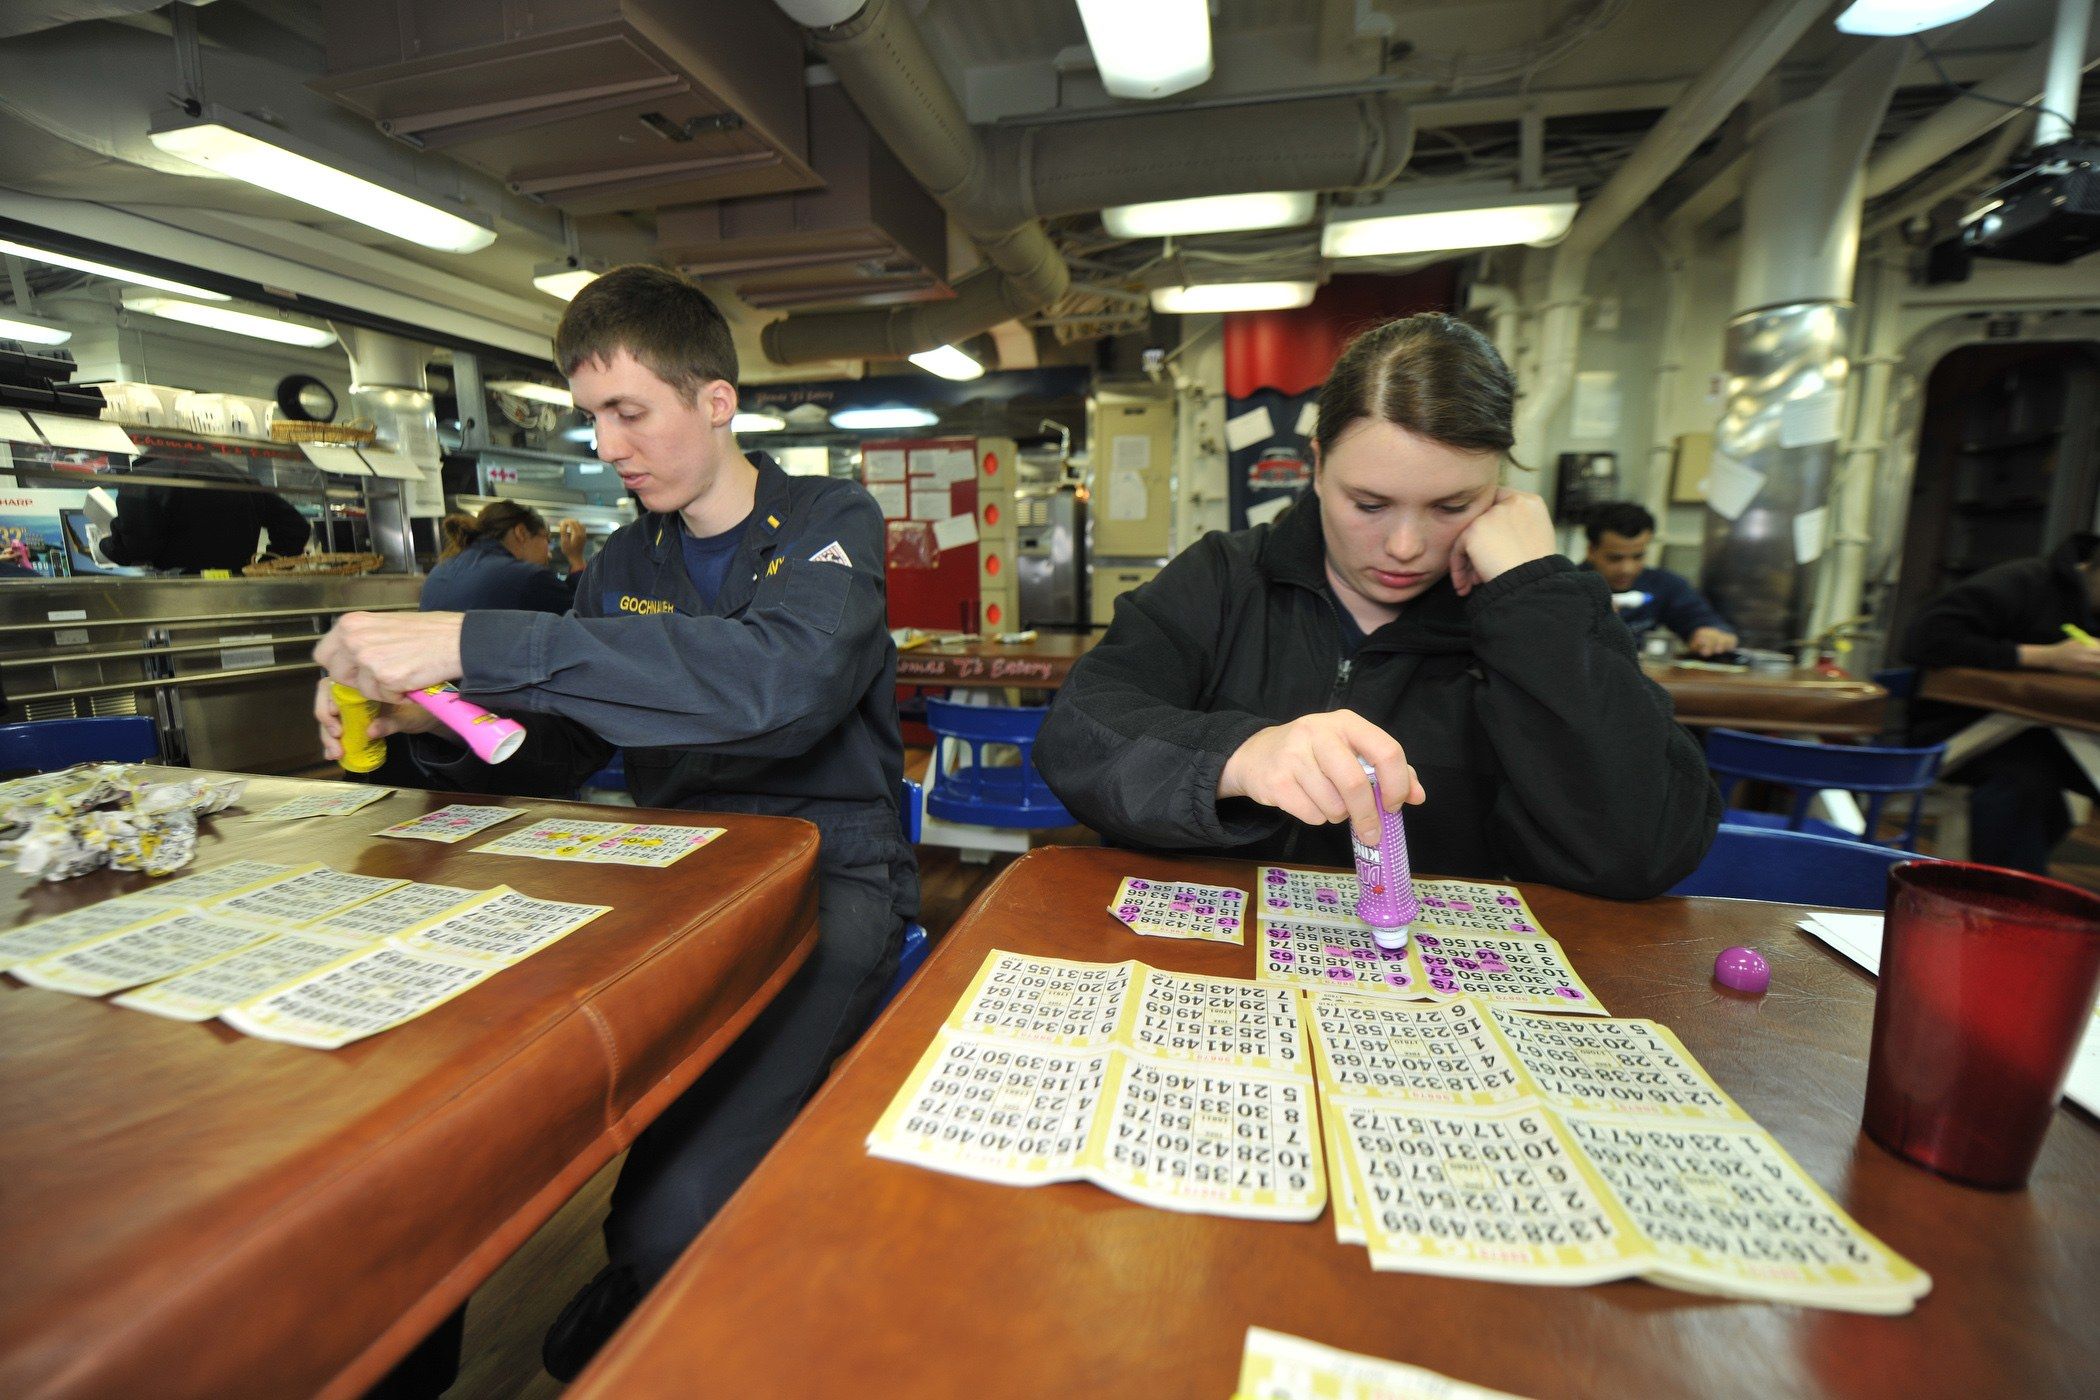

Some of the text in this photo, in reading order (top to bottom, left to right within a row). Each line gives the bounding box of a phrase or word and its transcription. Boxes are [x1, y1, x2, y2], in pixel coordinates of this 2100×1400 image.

[0, 499, 33, 507] HARP
[764, 555, 786, 578] AVY
[898, 660, 946, 674] omas
[1130, 880, 1150, 890] 67
[1177, 886, 1196, 895] 31
[1199, 889, 1219, 898] 28
[1222, 890, 1242, 899] 12
[1127, 889, 1240, 908] 11 30 44 53 66
[1146, 900, 1168, 909] 47
[1119, 906, 1239, 926] 13 21 33 52 62
[1194, 905, 1215, 915] 18
[1219, 908, 1239, 917] 15
[1140, 916, 1161, 925] 58
[1165, 919, 1187, 928] 42
[1190, 924, 1212, 933] 25
[1269, 921, 1371, 938] 22 33 47 71
[425, 929, 448, 943] 75
[466, 939, 488, 951] 32
[1268, 929, 1372, 949] 19 38 55 75
[1414, 934, 1547, 953] 5 16 31 56 63
[487, 943, 511, 955] 22
[513, 946, 528, 955] 6
[1269, 939, 1404, 962] 14 25 56 74
[1419, 944, 1555, 966] 3 26 44 46 61
[1269, 949, 1402, 973] 5 18 45 51 62
[1422, 954, 1568, 978] 10 24 48 64
[1269, 962, 1407, 986] 6 27 44 46 70
[1428, 967, 1570, 987] 4 30 39 50 67
[1151, 974, 1289, 1000] 7 24 43 57 72
[1430, 979, 1580, 998] 1 22 33 59 75
[978, 998, 1117, 1021] 5 22 45 53 62
[1148, 988, 1289, 1013] 1 29 42 46 67
[973, 1011, 1113, 1036] 9 16 34 57 61
[1145, 1001, 1297, 1029] 11 27 49 69
[1145, 1015, 1292, 1043] 5 25 31 51 71
[1140, 1030, 1295, 1060] 6 18 41 48 75
[1331, 1054, 1495, 1072] 4 26 40 47 68
[1131, 1067, 1297, 1102] 5 21 41 46 67
[1339, 1069, 1515, 1091] 13 18 32 56 67
[1350, 1114, 1538, 1139] 9 17 41 51 72
[1119, 1123, 1307, 1169] 10 28 42 60 74
